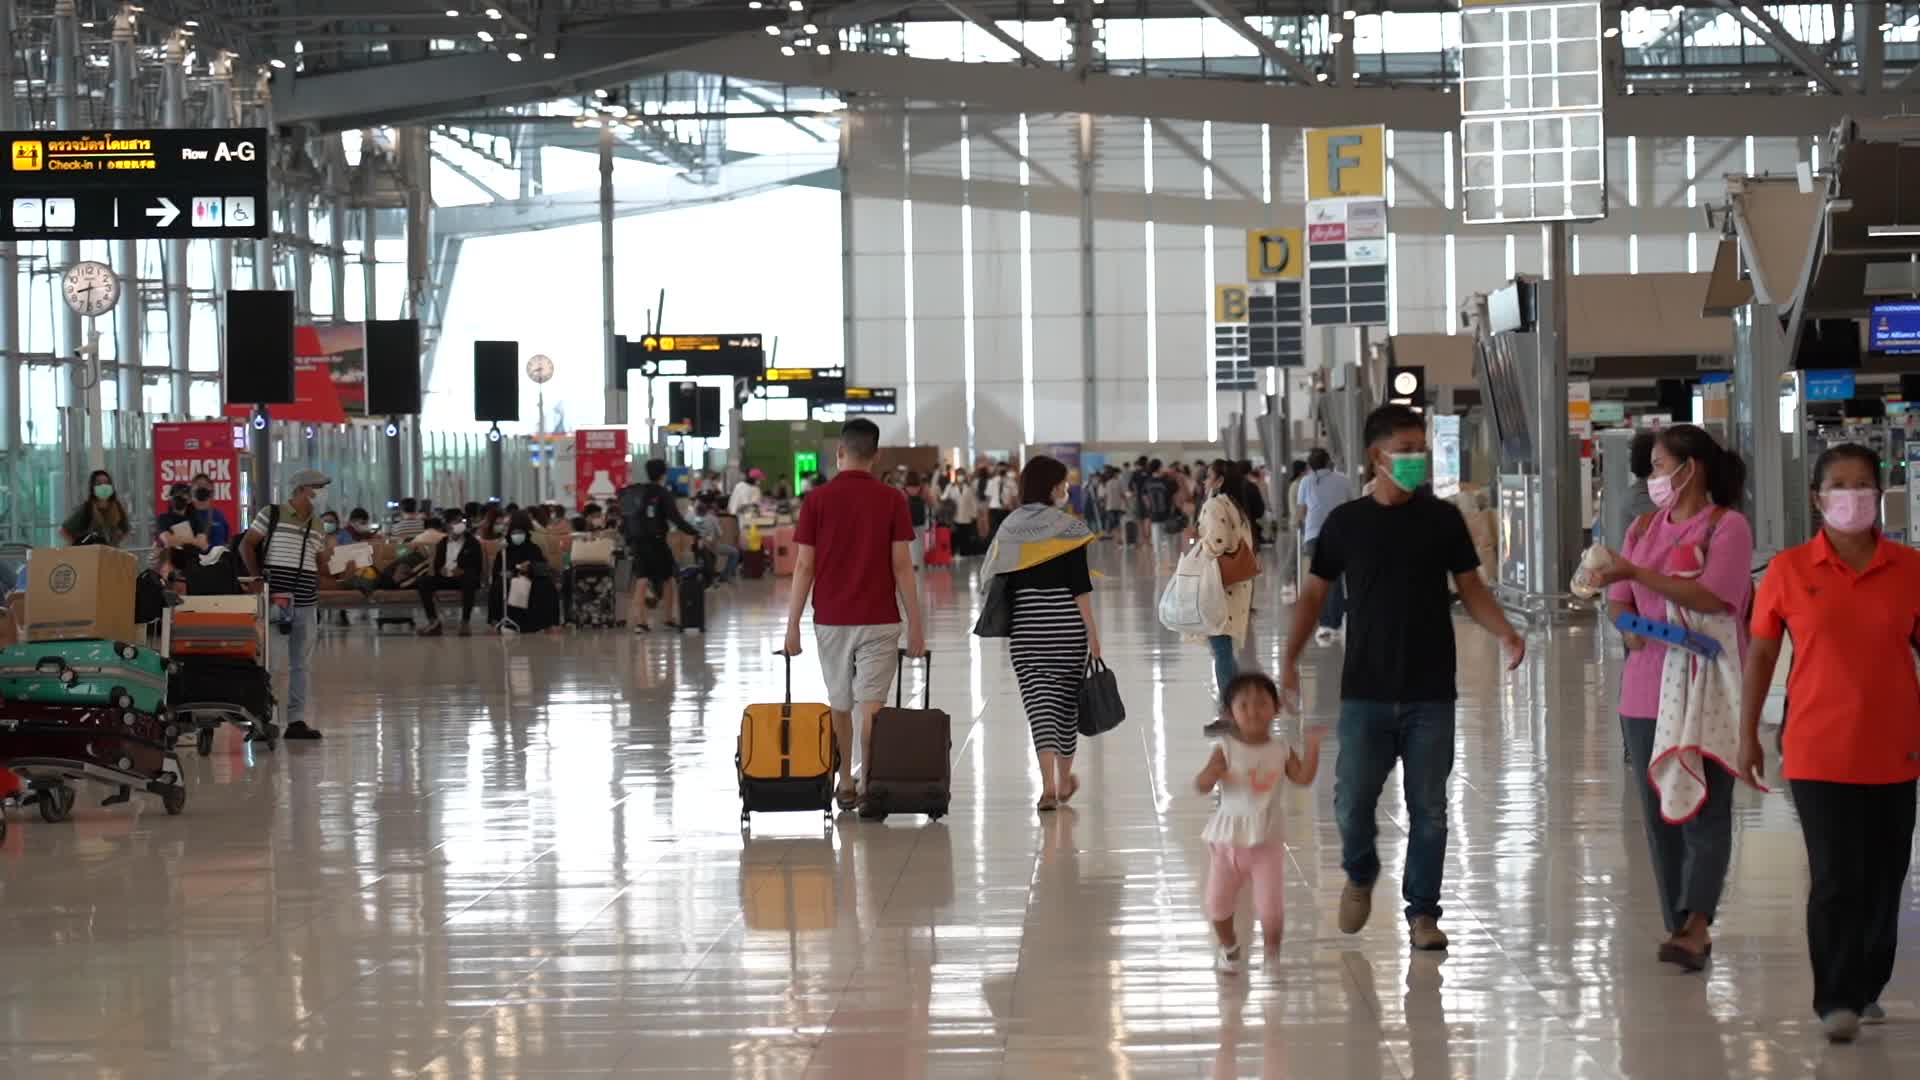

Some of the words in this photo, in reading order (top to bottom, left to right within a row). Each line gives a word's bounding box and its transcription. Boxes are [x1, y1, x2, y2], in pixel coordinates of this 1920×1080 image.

[182, 149, 208, 160] Row
[214, 141, 256, 162] A-G
[1327, 135, 1362, 193] F
[48, 160, 94, 170] Check-in
[1259, 235, 1290, 274] D
[1223, 288, 1246, 319] B
[161, 459, 231, 481] SNACK
